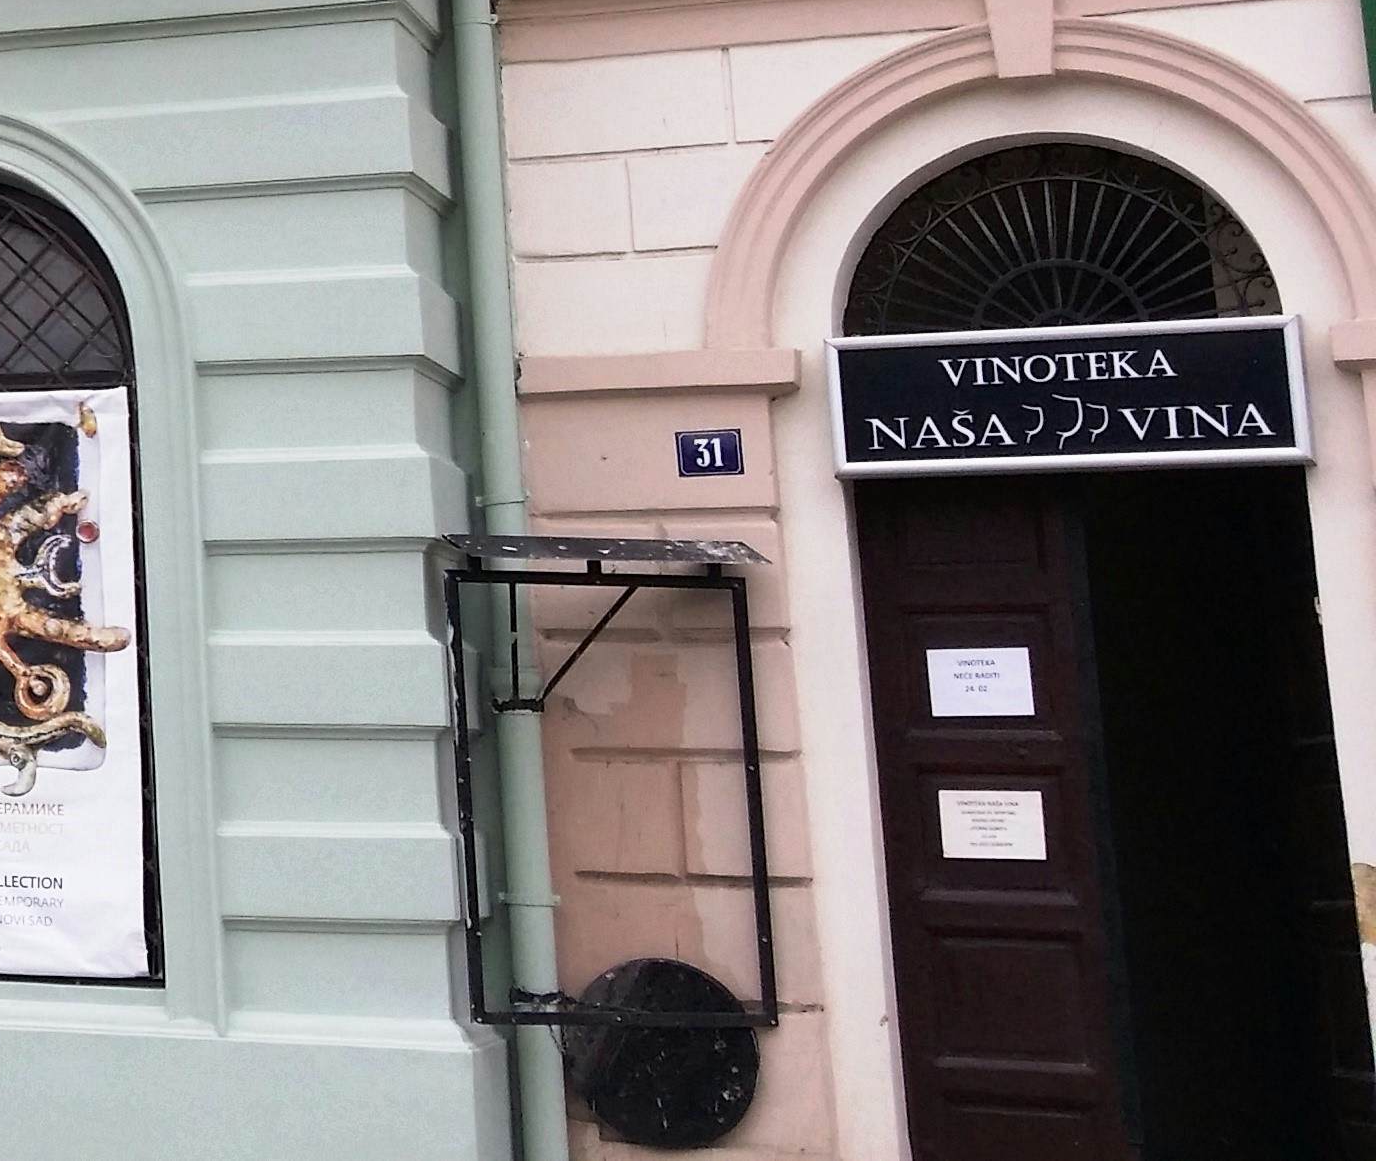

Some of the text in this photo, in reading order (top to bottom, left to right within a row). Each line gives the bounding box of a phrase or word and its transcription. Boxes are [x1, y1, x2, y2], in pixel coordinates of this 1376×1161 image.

[939, 349, 1178, 387] VINOTEKA
[864, 403, 1277, 450] NAŠA VINA
[693, 437, 724, 467] 31
[29, 915, 52, 927] SAD
